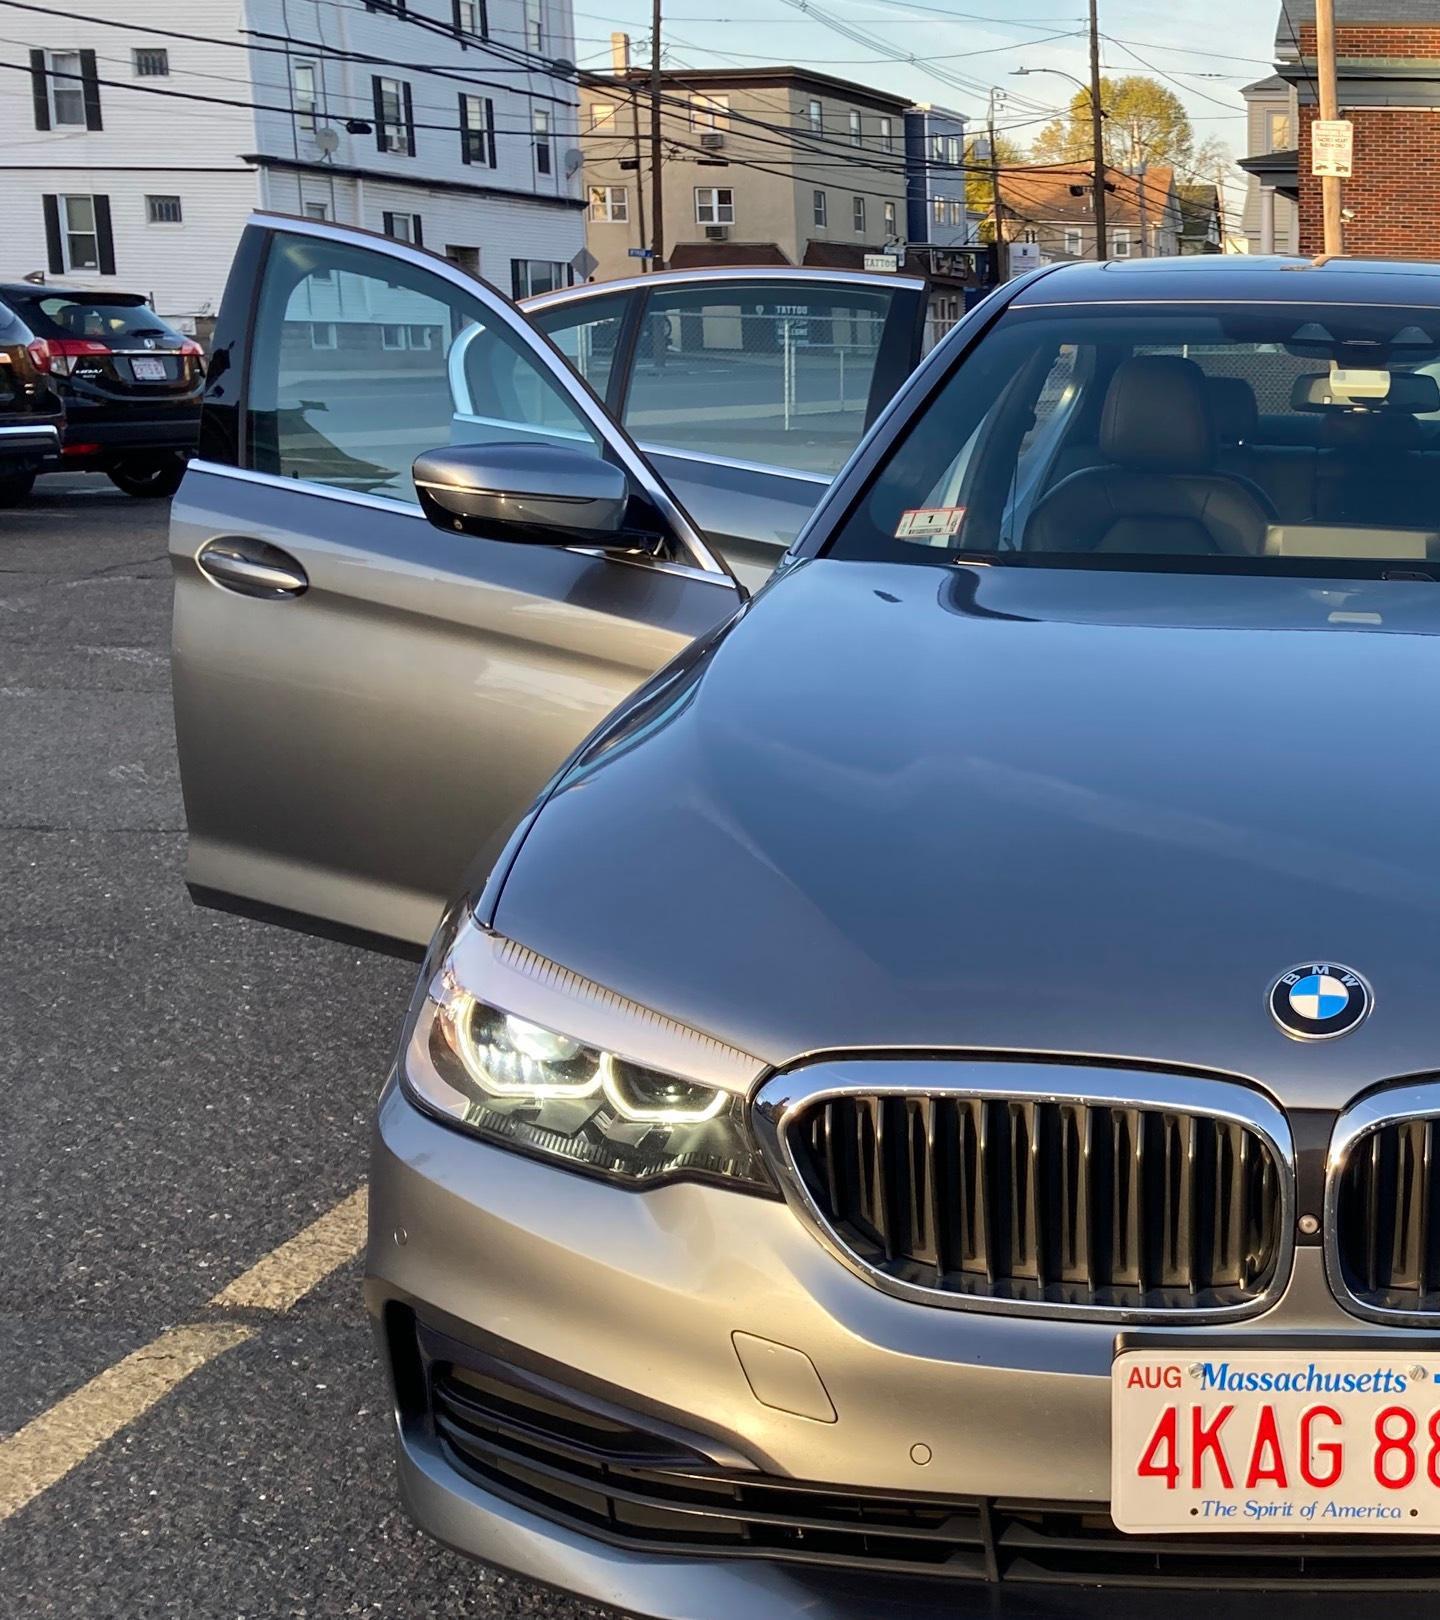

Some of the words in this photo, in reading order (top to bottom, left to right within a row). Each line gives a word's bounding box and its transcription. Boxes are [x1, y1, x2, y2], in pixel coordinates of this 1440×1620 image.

[864, 258, 896, 268] TATTOO
[776, 305, 808, 315] TATTOO
[1282, 963, 1360, 987] BMW
[1127, 1366, 1182, 1389] AUG
[1200, 1363, 1407, 1393] Massachusetts
[1137, 1405, 1343, 1489] 4KAG
[1202, 1500, 1236, 1517] The
[1243, 1500, 1293, 1520] Spirit
[1300, 1500, 1319, 1520] of
[1321, 1501, 1402, 1519] America
